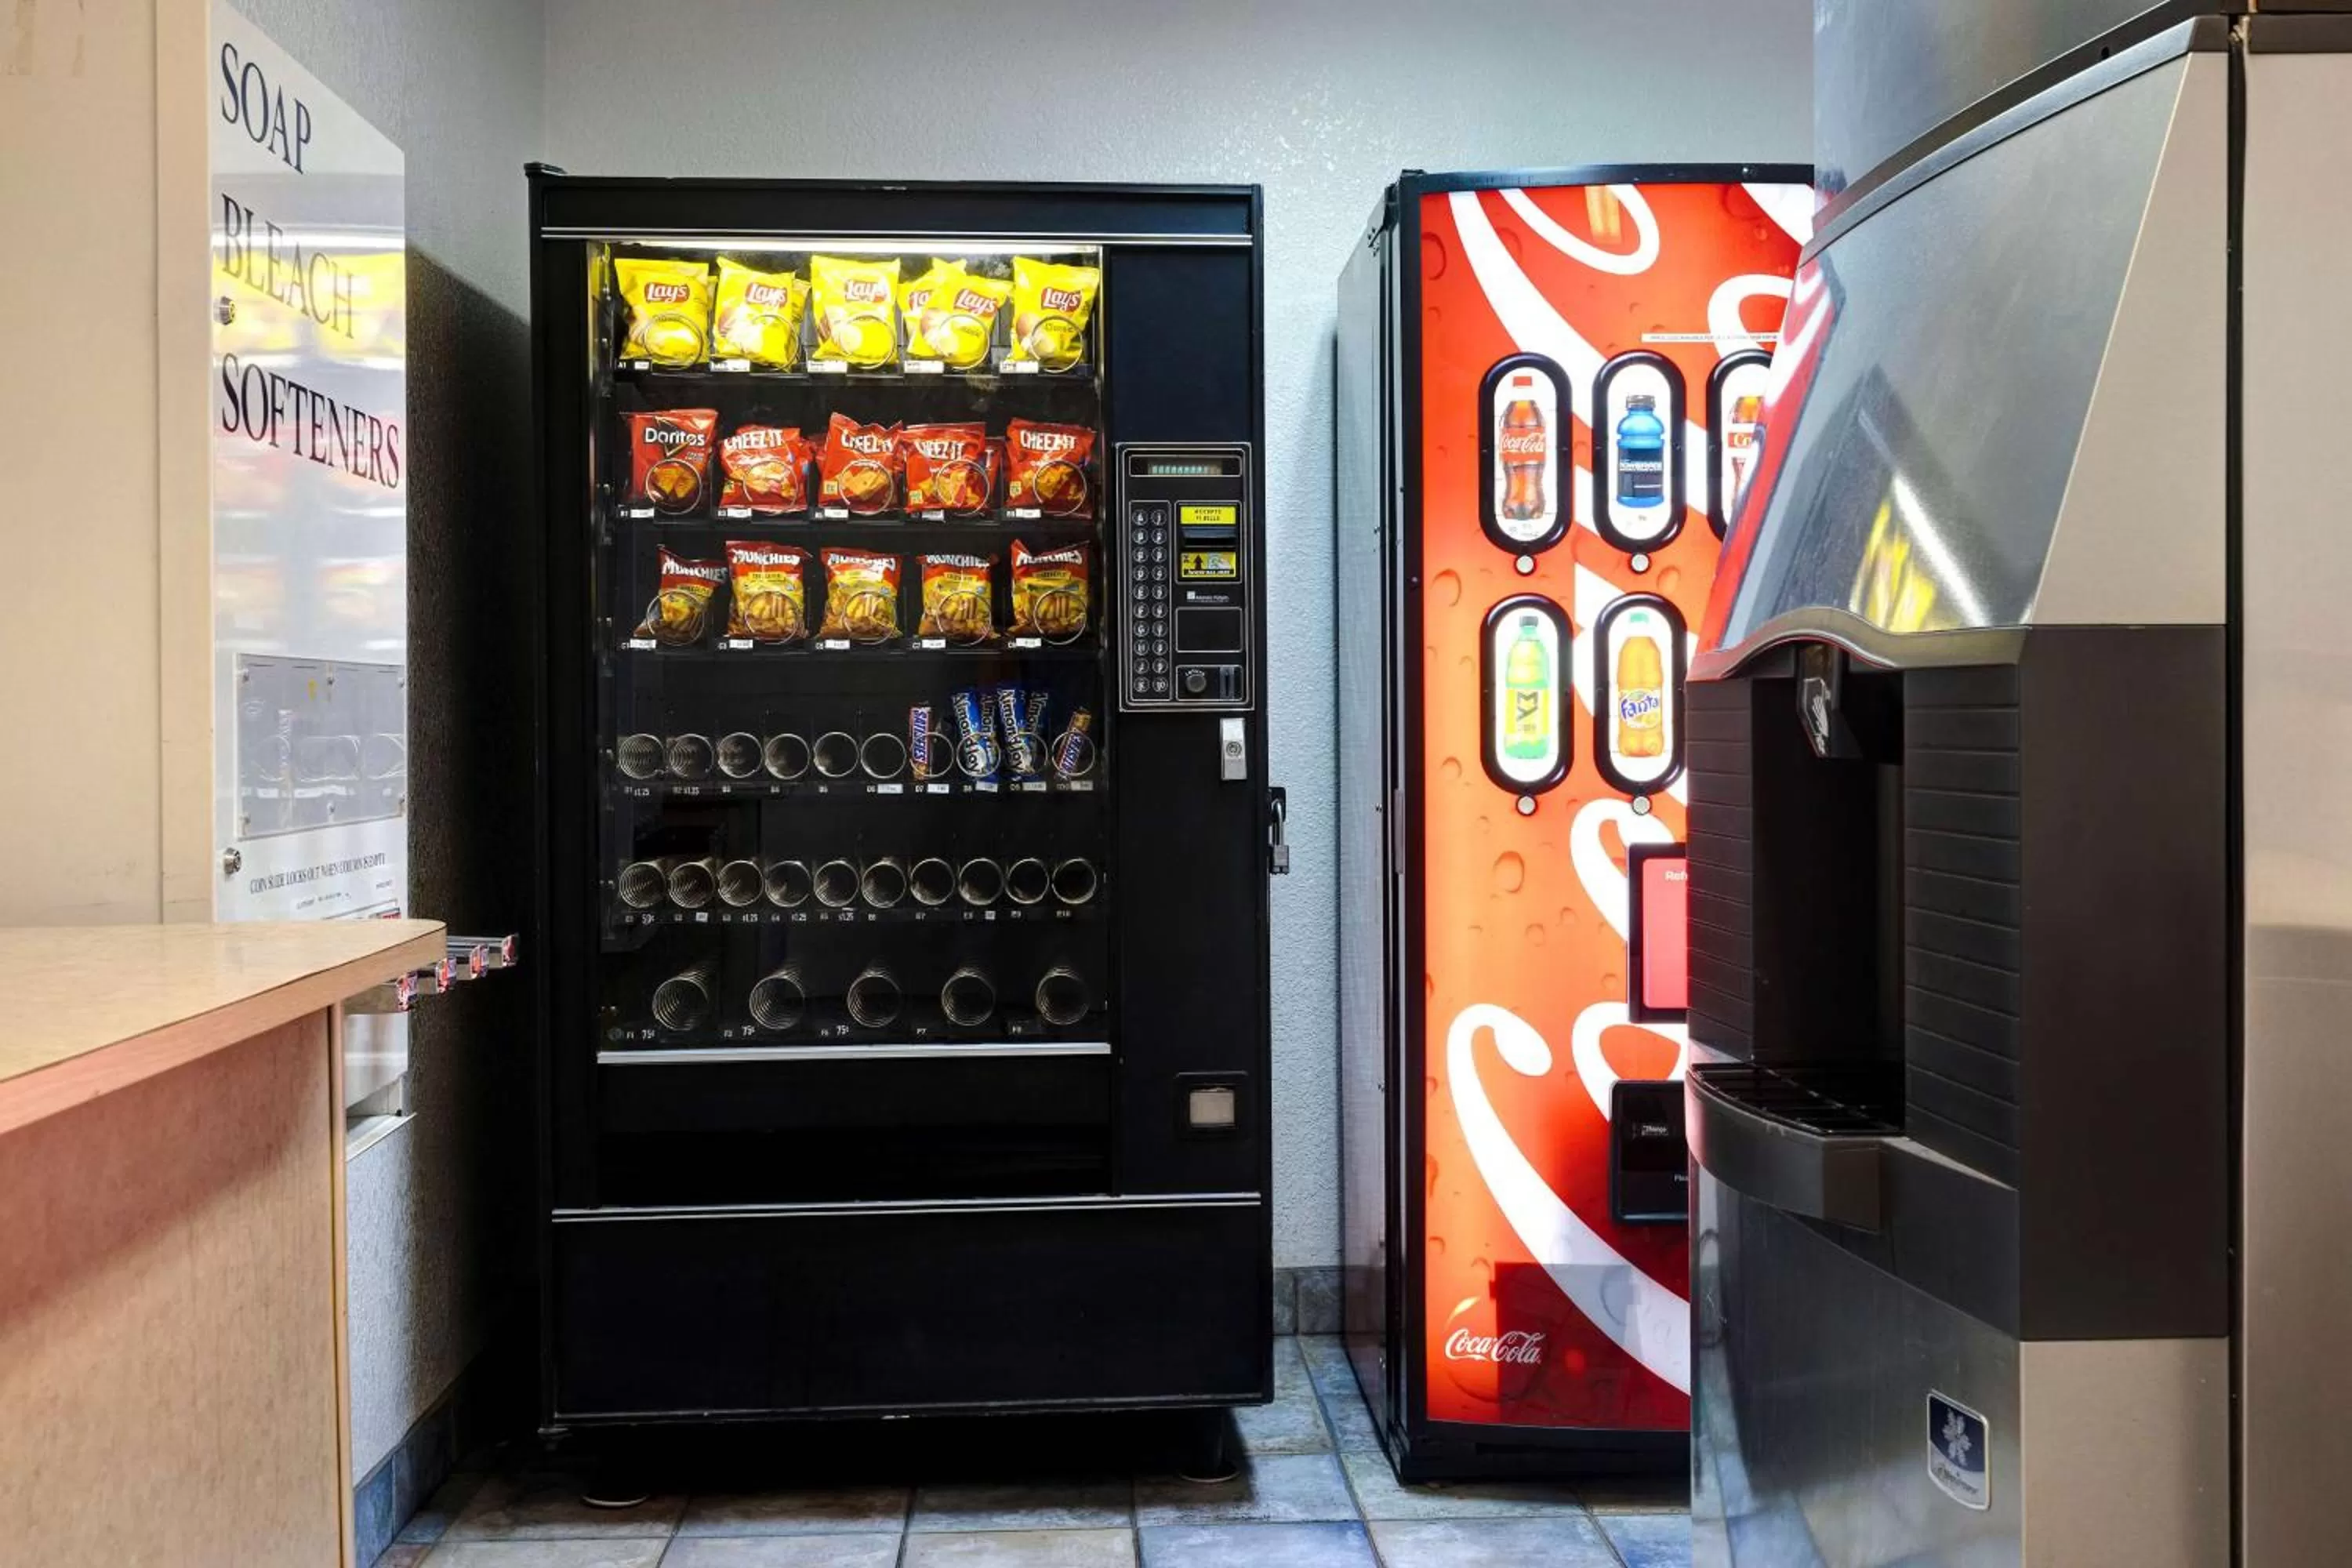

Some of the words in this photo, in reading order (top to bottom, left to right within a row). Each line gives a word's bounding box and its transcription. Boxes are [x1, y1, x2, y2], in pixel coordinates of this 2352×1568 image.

[221, 42, 313, 176] SOAP
[221, 192, 355, 340] BLEACH
[221, 352, 401, 490] SOFTENERS
[644, 427, 705, 446] Doritos
[1445, 1327, 1545, 1363] Coca-Cola
